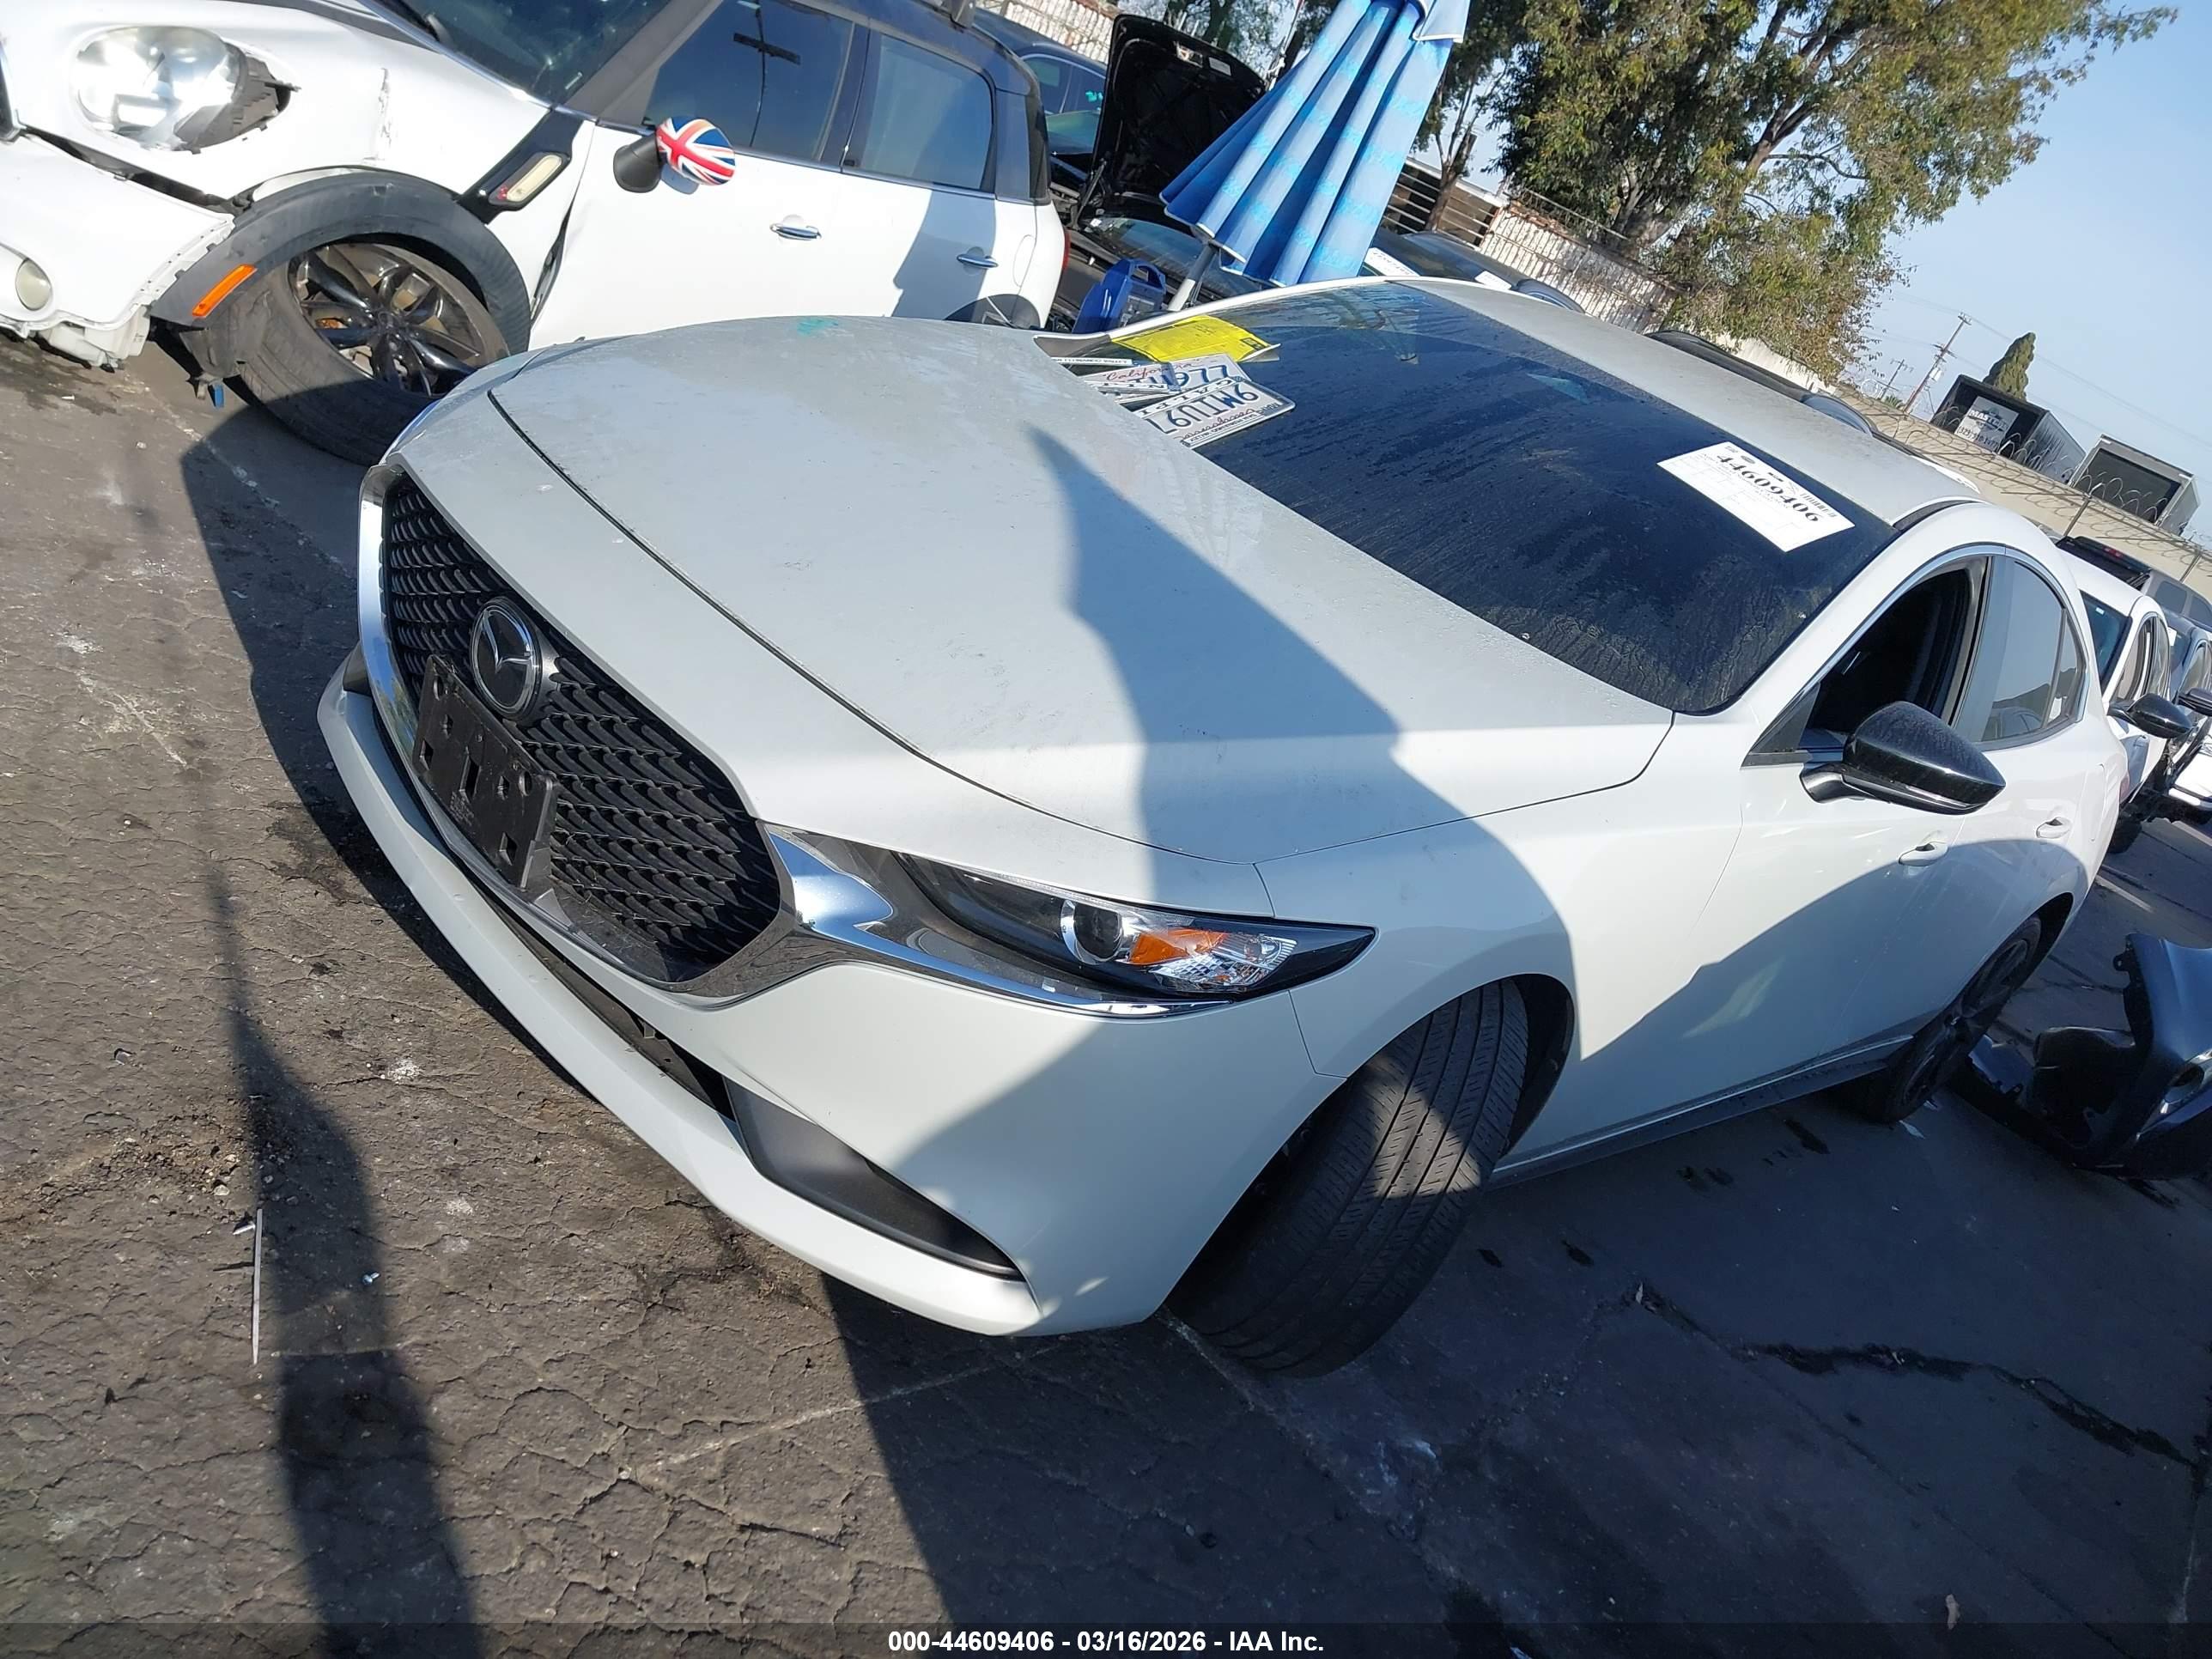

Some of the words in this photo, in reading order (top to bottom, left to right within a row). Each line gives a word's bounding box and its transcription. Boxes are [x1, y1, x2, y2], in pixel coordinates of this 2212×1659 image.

[1139, 380, 1232, 415] GALPI
[1146, 384, 1260, 434] 9MIU97
[1717, 453, 1820, 522] 44609406
